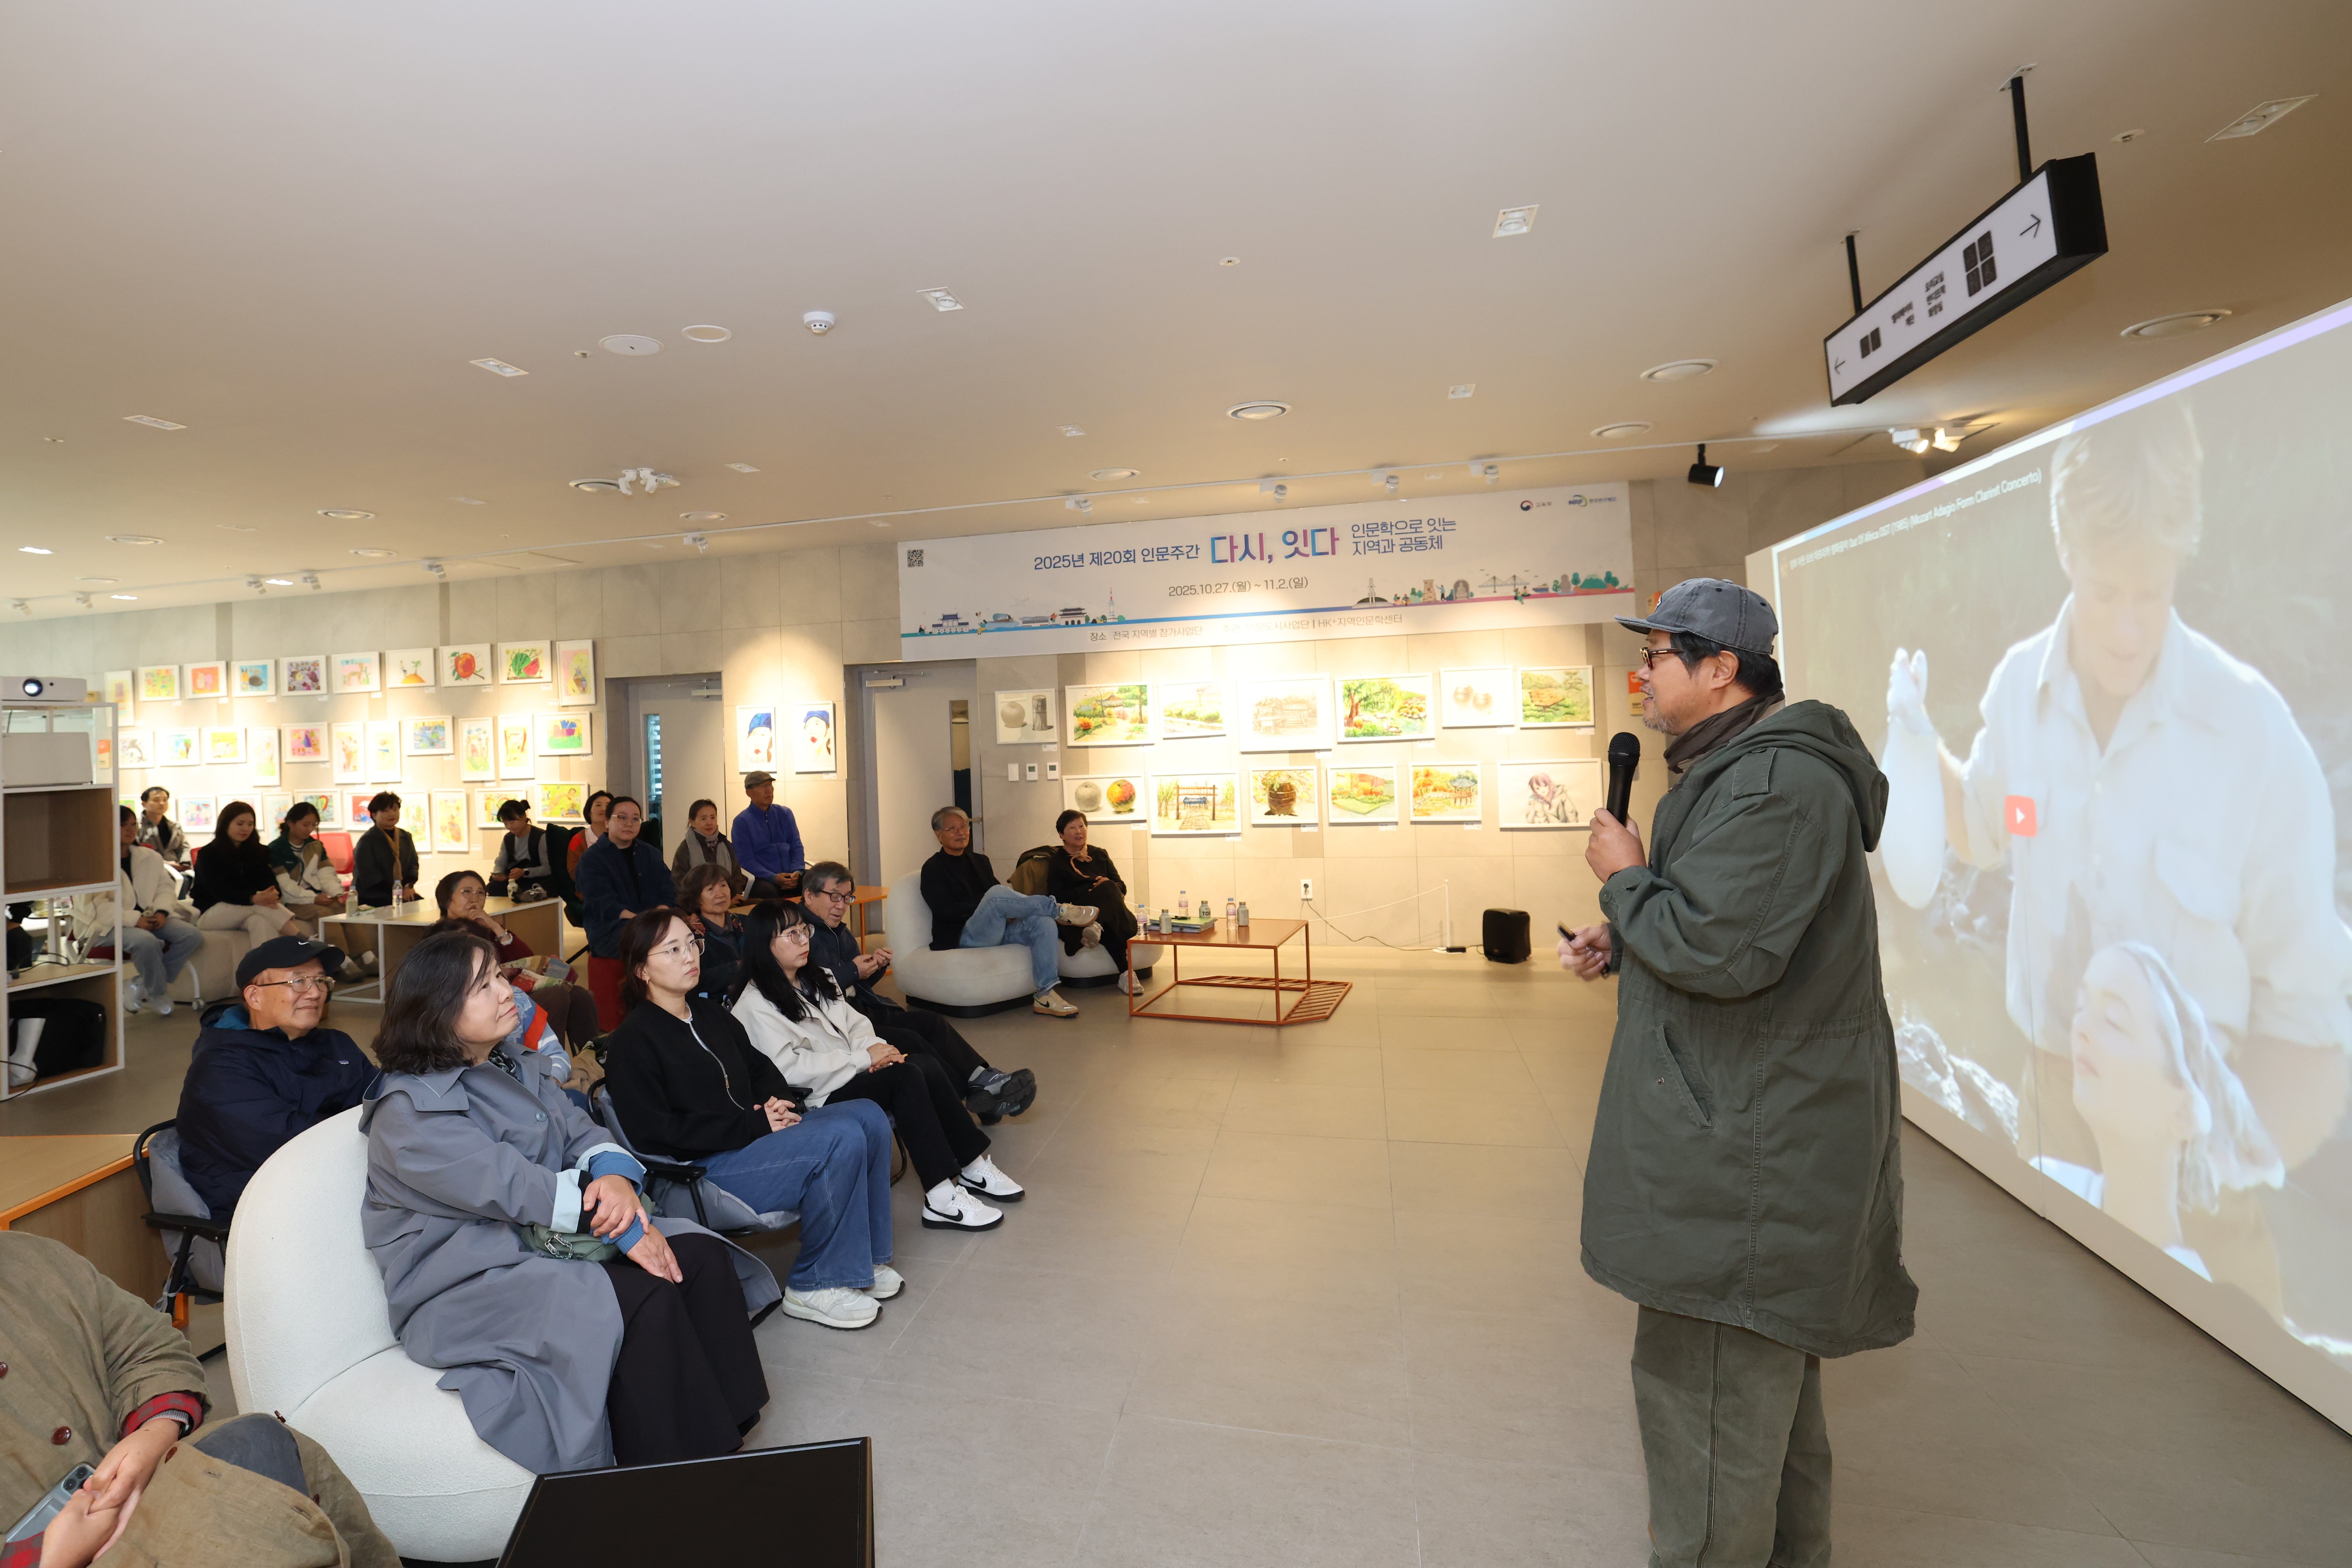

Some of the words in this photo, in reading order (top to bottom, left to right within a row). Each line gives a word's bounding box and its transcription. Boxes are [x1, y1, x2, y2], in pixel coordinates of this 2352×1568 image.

[1933, 502, 1956, 517] Adagio
[1351, 519, 1423, 538] 인문학으로
[1427, 517, 1456, 533] 잇는
[1035, 553, 1084, 570] 2025년
[1089, 549, 1136, 566] 제20회
[1141, 544, 1200, 562] 인문주간
[1211, 532, 1273, 564] 다시,
[1282, 527, 1340, 558] 잇다
[1353, 539, 1395, 556] 지역과
[1399, 535, 1443, 552] 공동체
[1169, 580, 1250, 597] 2025.10.27.(월)
[1264, 576, 1308, 590] 11.2.(일)
[1090, 632, 1107, 642] 장소
[1113, 630, 1129, 640] 전국
[1132, 629, 1157, 639] 지역별
[1160, 626, 1202, 637] 참가사업단
